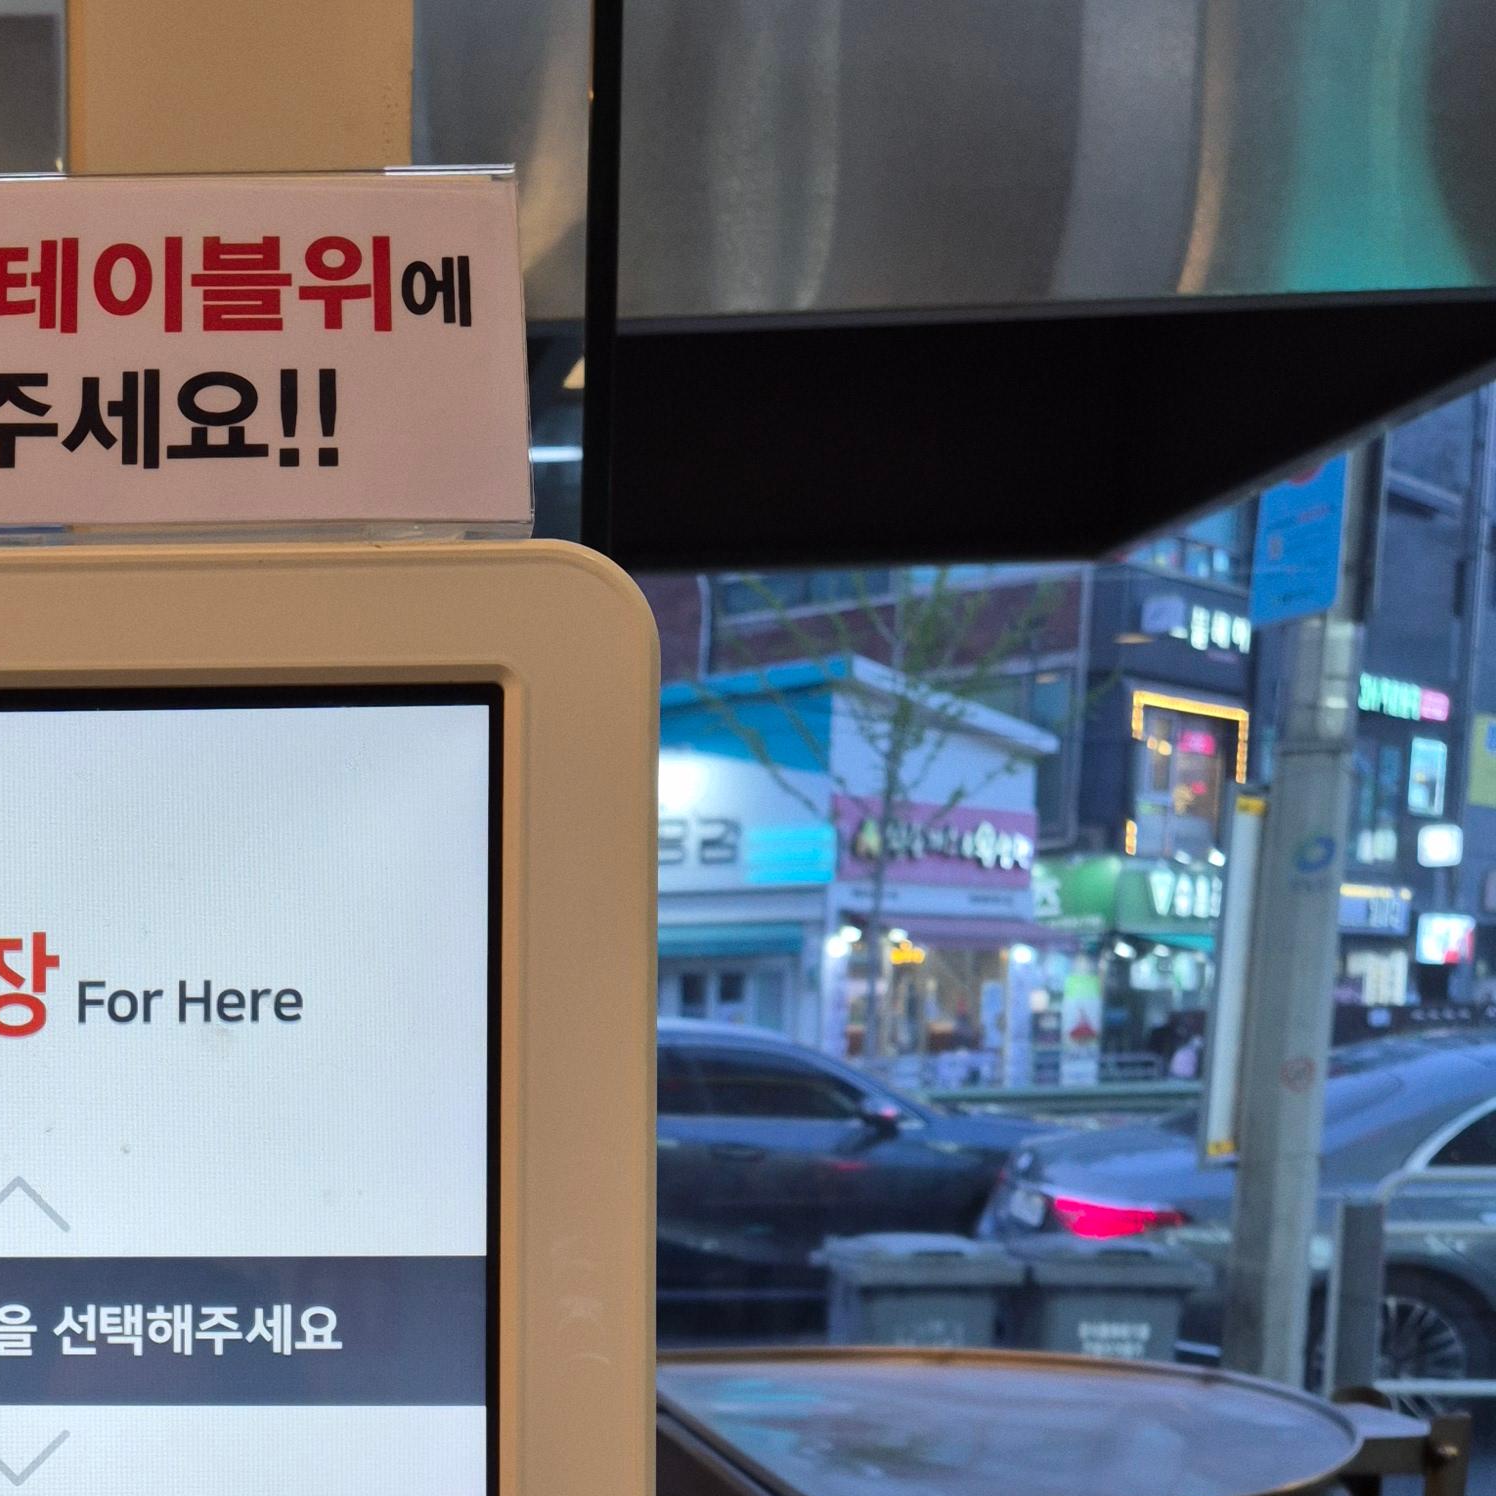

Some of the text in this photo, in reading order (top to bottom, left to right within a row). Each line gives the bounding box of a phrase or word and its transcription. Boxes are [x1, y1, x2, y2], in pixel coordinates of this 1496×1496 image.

[77, 980, 165, 1025] For
[178, 979, 304, 1024] Here
[52, 1304, 344, 1358] 선택해주세요
